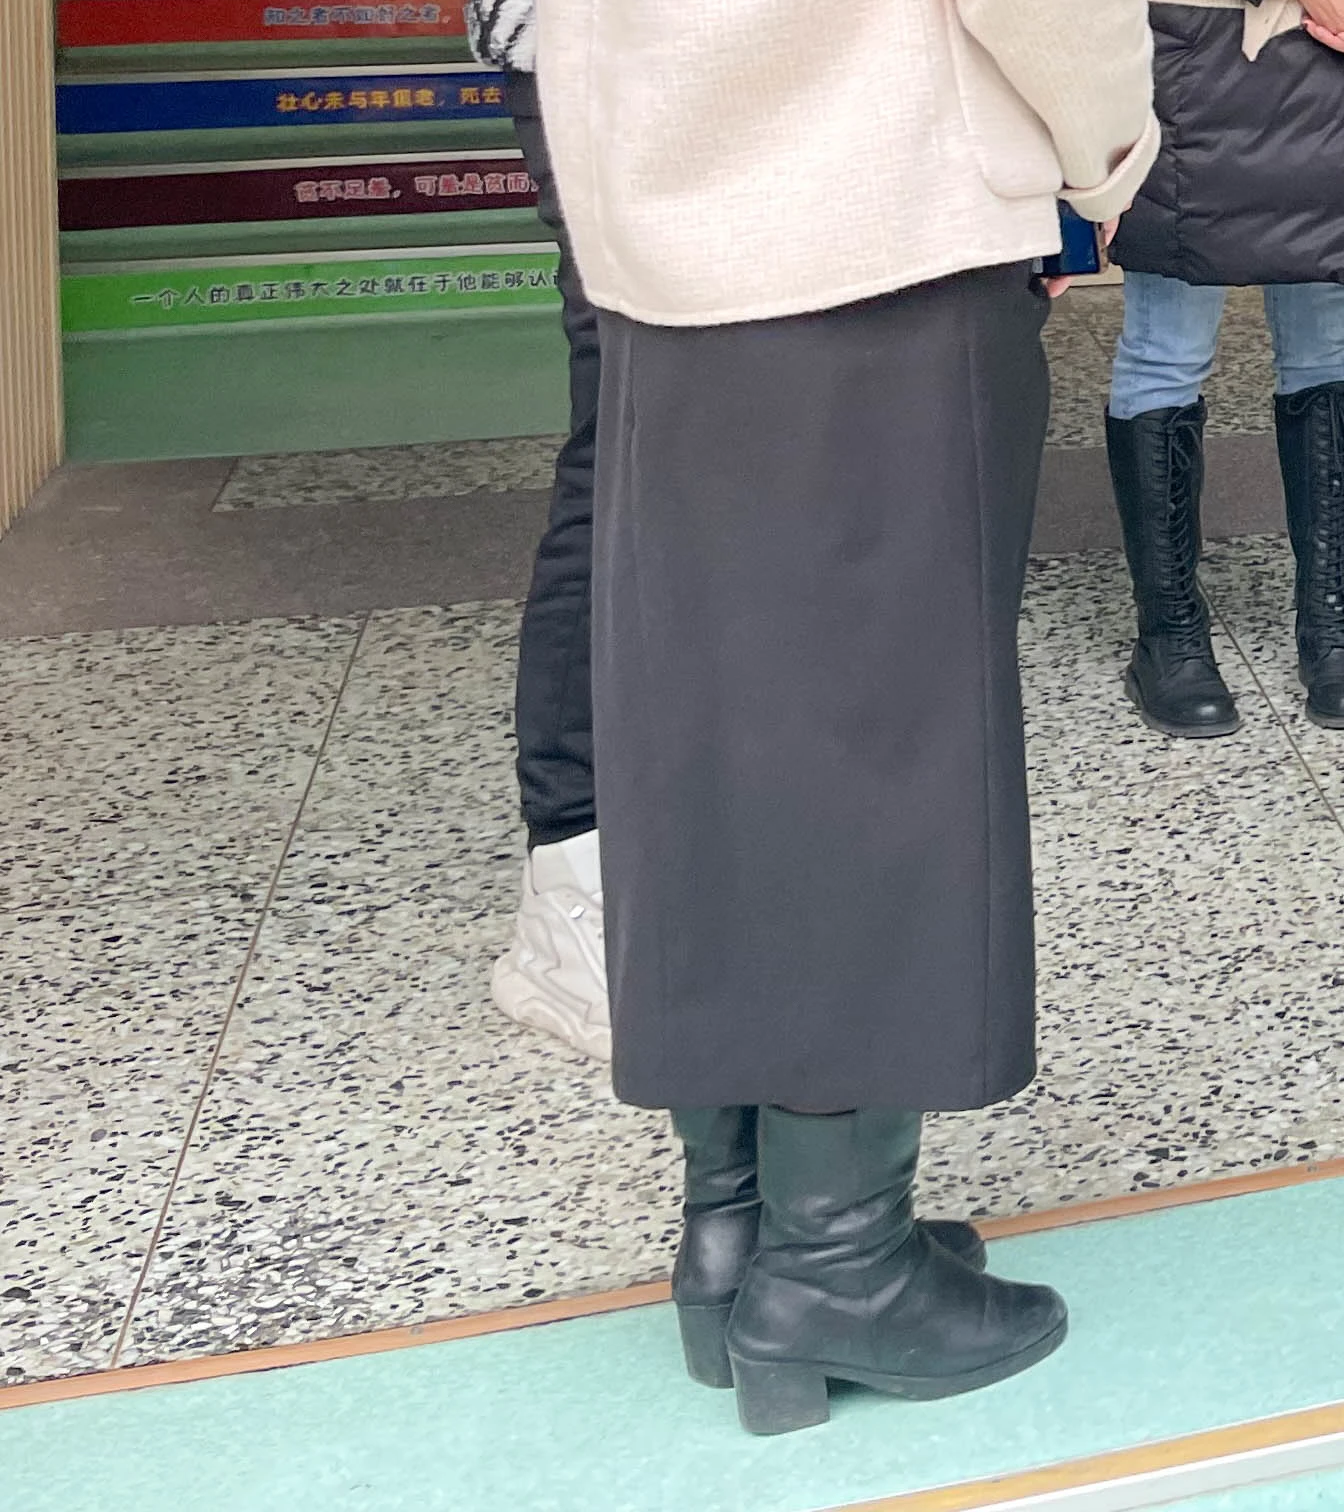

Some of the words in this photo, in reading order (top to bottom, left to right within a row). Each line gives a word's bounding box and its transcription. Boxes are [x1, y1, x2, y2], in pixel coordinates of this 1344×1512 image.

[414, 172, 538, 197] 可羞是贫而
